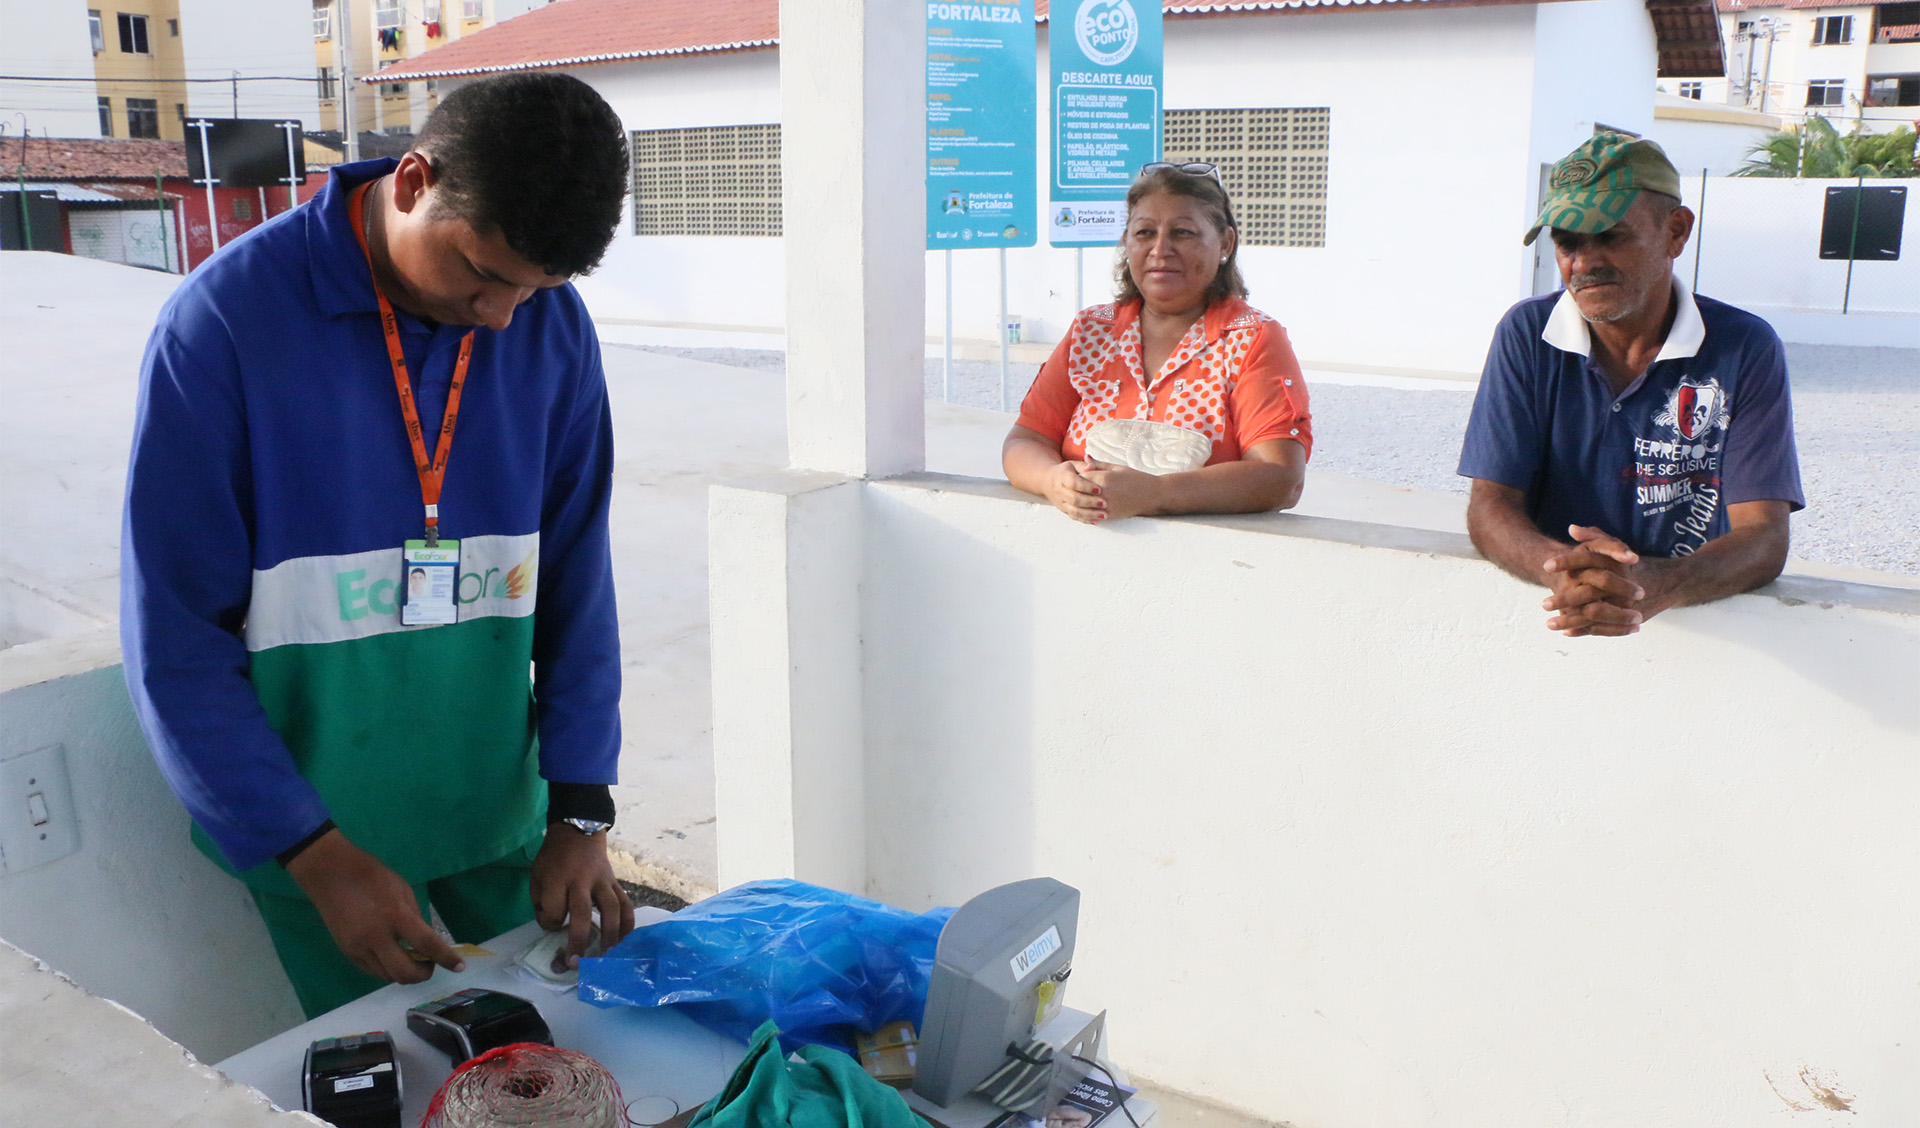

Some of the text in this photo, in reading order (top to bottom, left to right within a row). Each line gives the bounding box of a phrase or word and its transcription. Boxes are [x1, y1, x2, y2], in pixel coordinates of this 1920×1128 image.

[927, 4, 1022, 23] FORTALEZA
[1092, 28, 1129, 47] PONTO
[1062, 72, 1153, 85] DESCARTE AQUI
[1067, 131, 1083, 139] ÓLEO
[969, 200, 1014, 209] Fortaleza
[1078, 216, 1115, 224] Fortaleza
[1634, 437, 1706, 461] FERRERO
[1635, 462, 1655, 475] THE
[1015, 933, 1056, 972] Welmy
[1093, 1088, 1109, 1097] dos
[1091, 1096, 1113, 1108] Como
